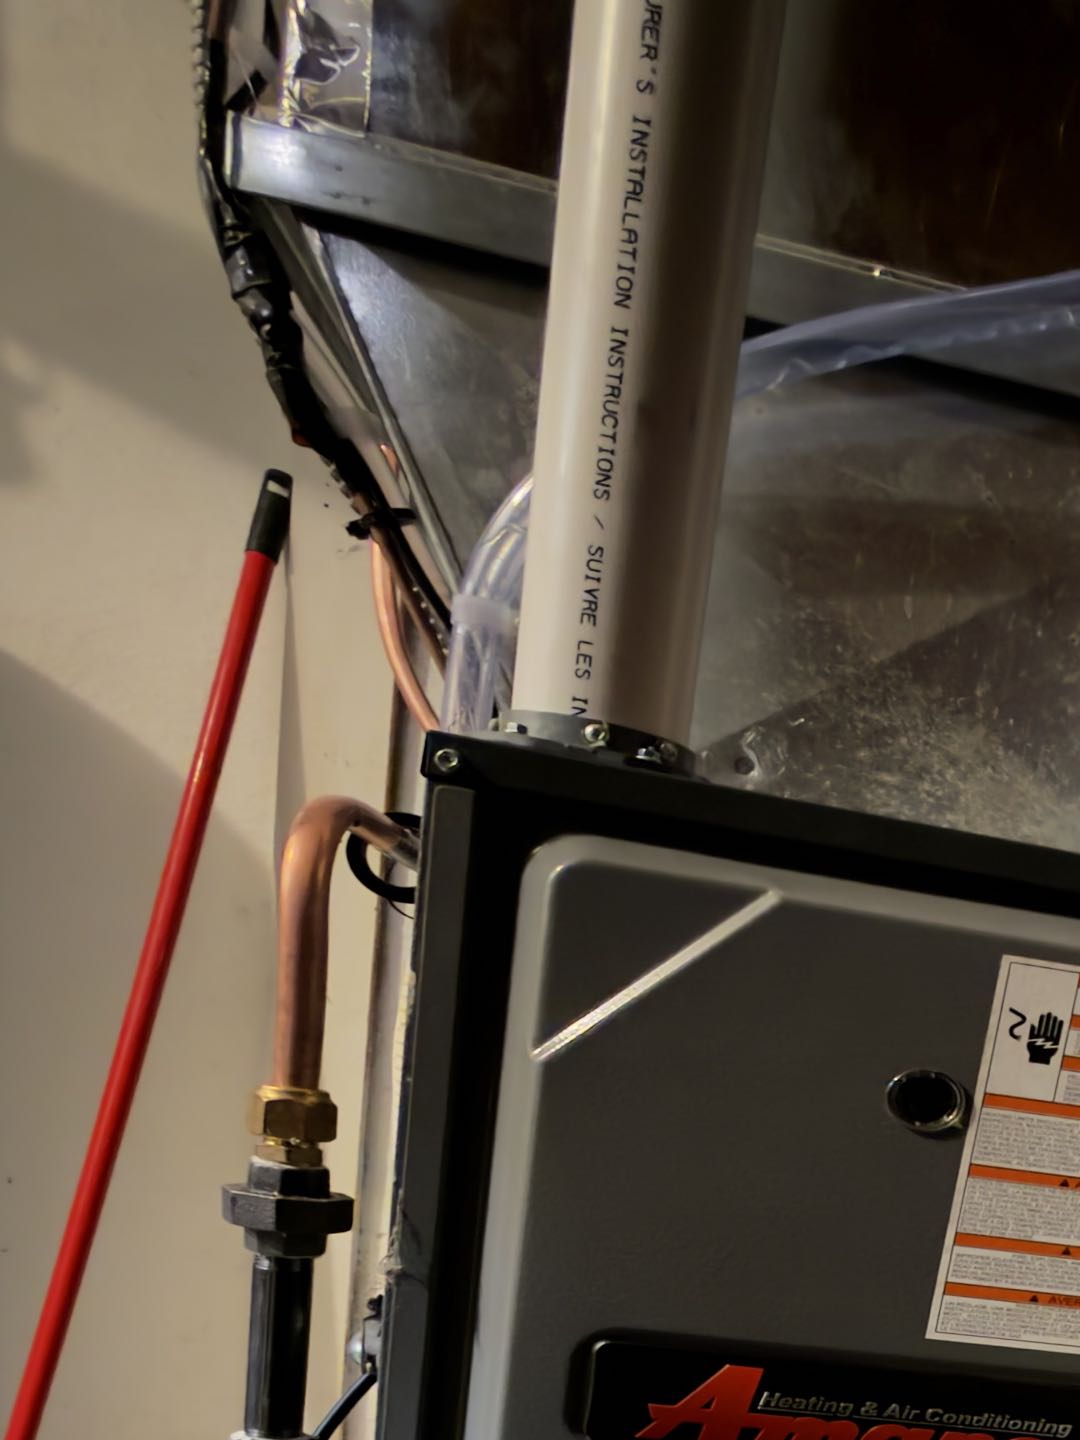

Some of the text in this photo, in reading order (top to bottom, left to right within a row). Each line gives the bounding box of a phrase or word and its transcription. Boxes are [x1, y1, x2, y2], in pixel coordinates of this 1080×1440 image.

[614, 115, 652, 310] INSTALLATION
[593, 326, 629, 501] INSTRUCTIONS
[580, 545, 605, 627] SUIVRE
[575, 639, 595, 681] LES
[758, 1391, 1072, 1439] Heating & Air Conditioning
